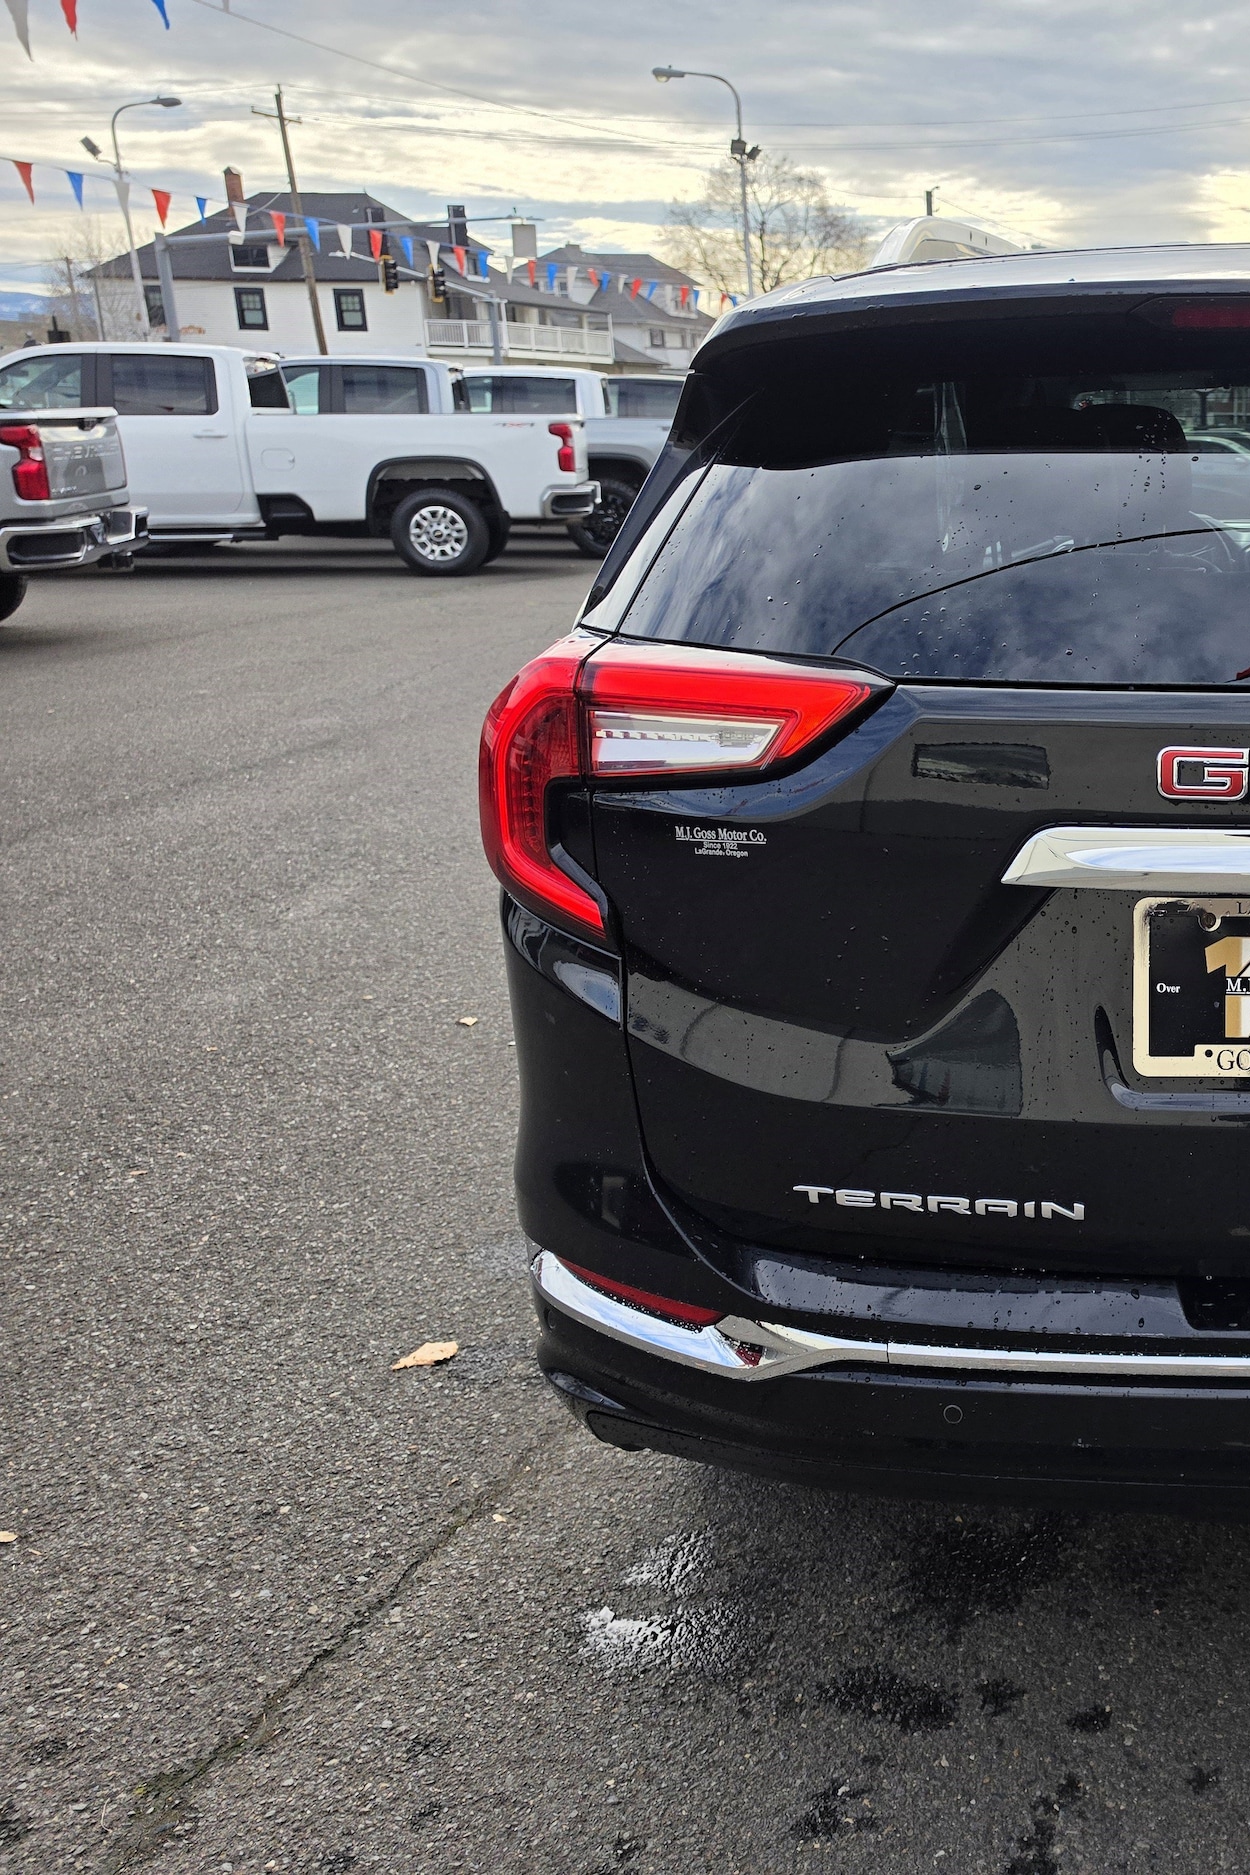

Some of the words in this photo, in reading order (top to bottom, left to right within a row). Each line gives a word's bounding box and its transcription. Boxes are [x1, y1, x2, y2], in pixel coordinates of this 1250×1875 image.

[693, 826, 717, 840] Goss
[718, 828, 748, 841] Motor
[749, 829, 768, 842] Co.
[703, 841, 721, 849] Since
[725, 849, 749, 858] Oregon
[1156, 983, 1181, 994] Over
[793, 1184, 1085, 1221] TERRAIN
